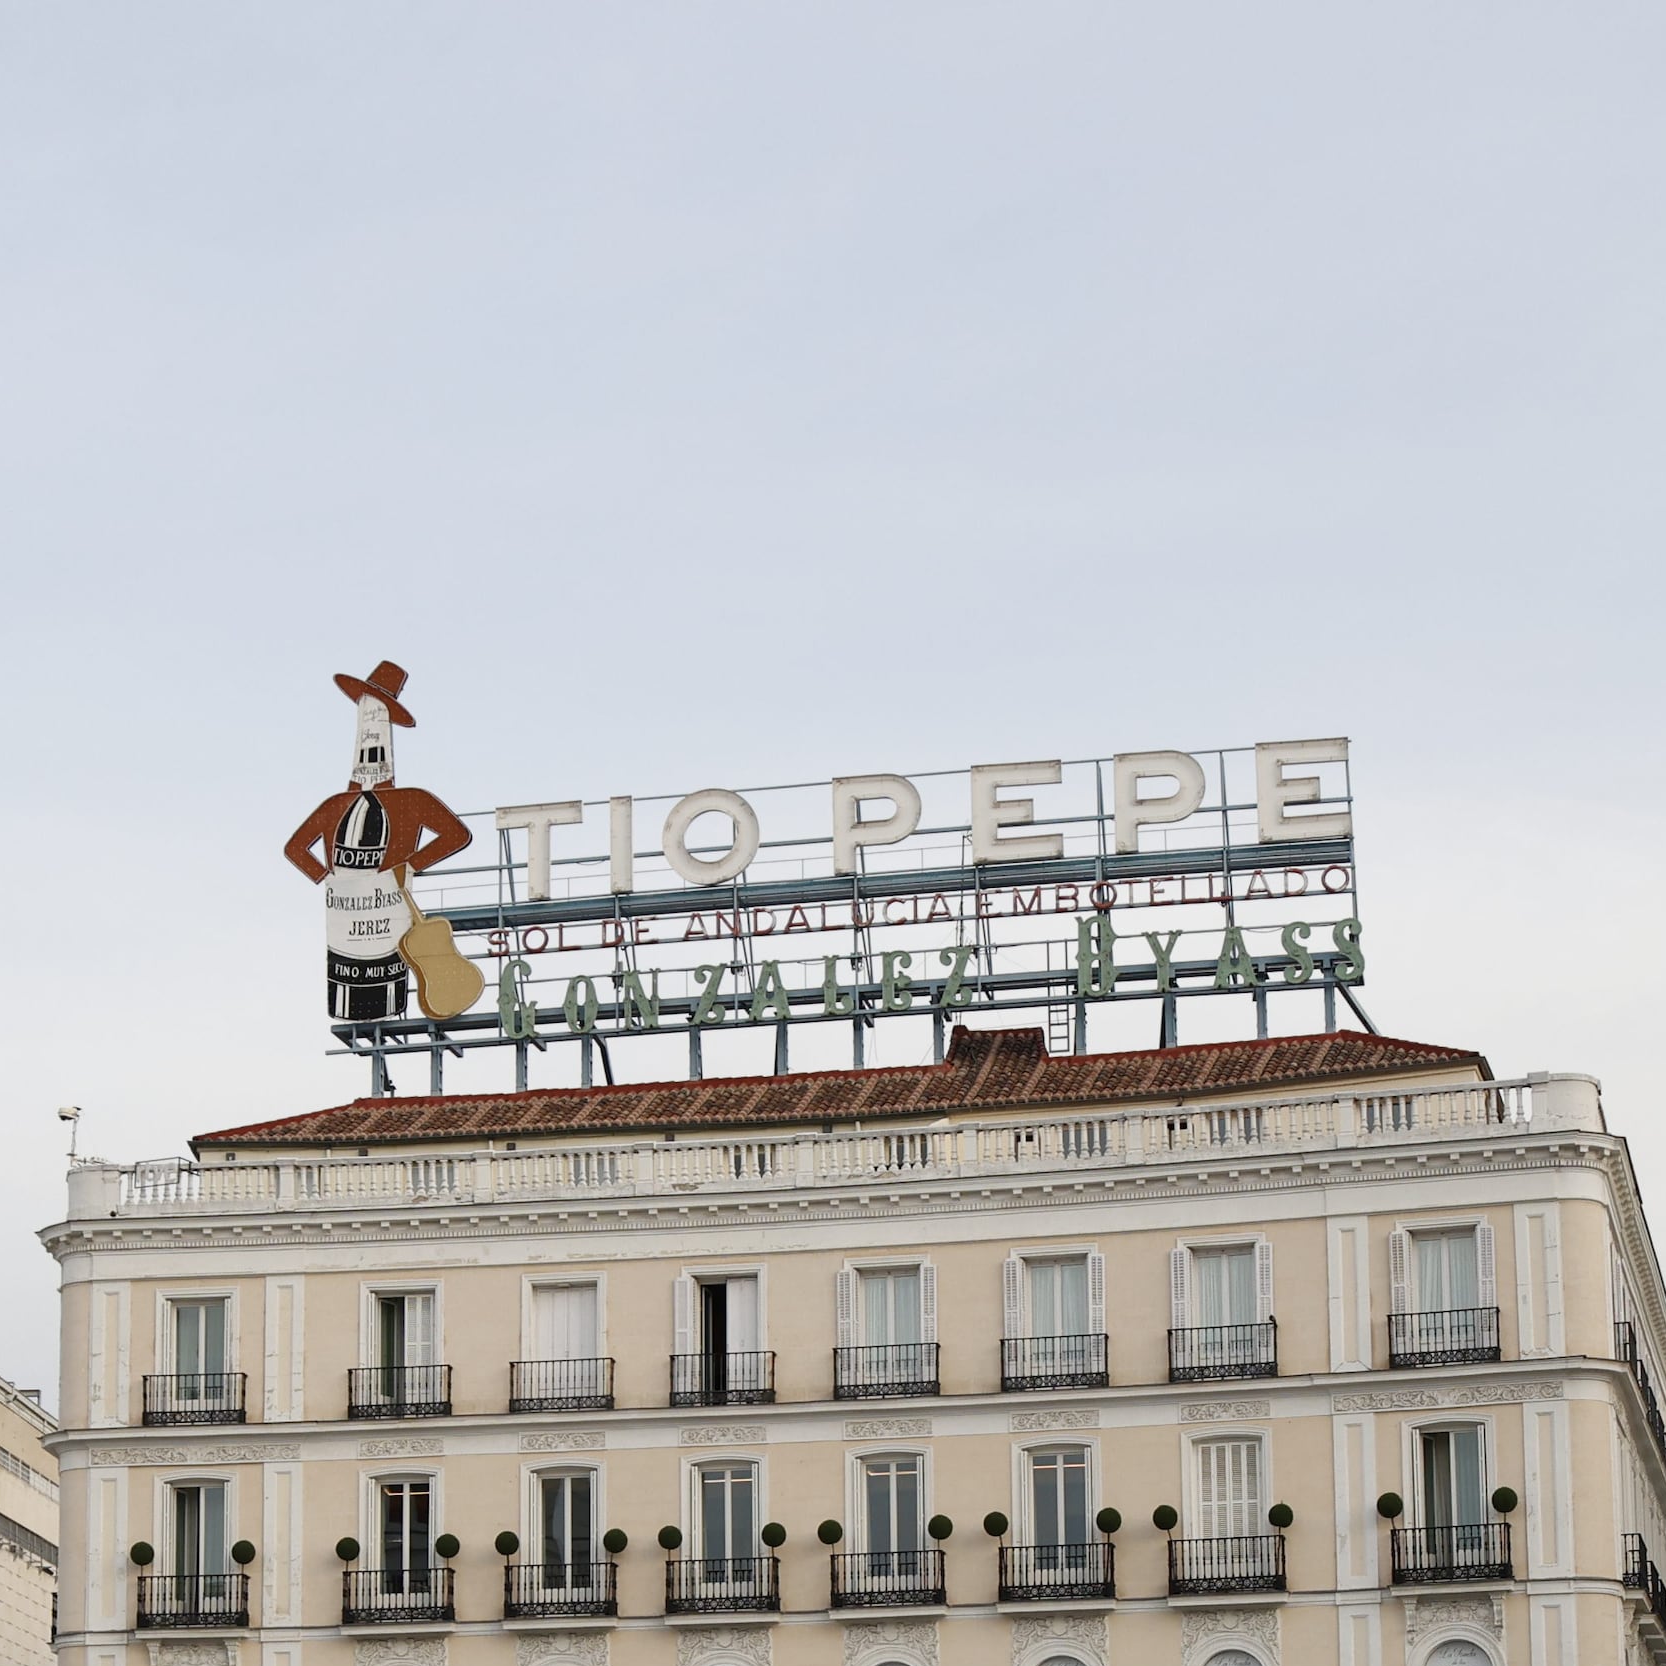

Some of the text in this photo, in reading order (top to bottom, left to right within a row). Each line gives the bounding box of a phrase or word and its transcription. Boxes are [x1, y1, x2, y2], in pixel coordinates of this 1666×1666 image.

[495, 736, 1352, 901] TIO PEPE
[335, 848, 354, 867] TIO
[326, 886, 403, 911] GONZALEZ BYASS
[487, 864, 1350, 956] SOL DE ANDALUCIA EMBOTELLADO
[349, 918, 390, 936] JEREZ
[335, 962, 360, 978] FINO
[365, 963, 386, 978] MUY
[497, 914, 1365, 1040] GONZALEZ BYASS
